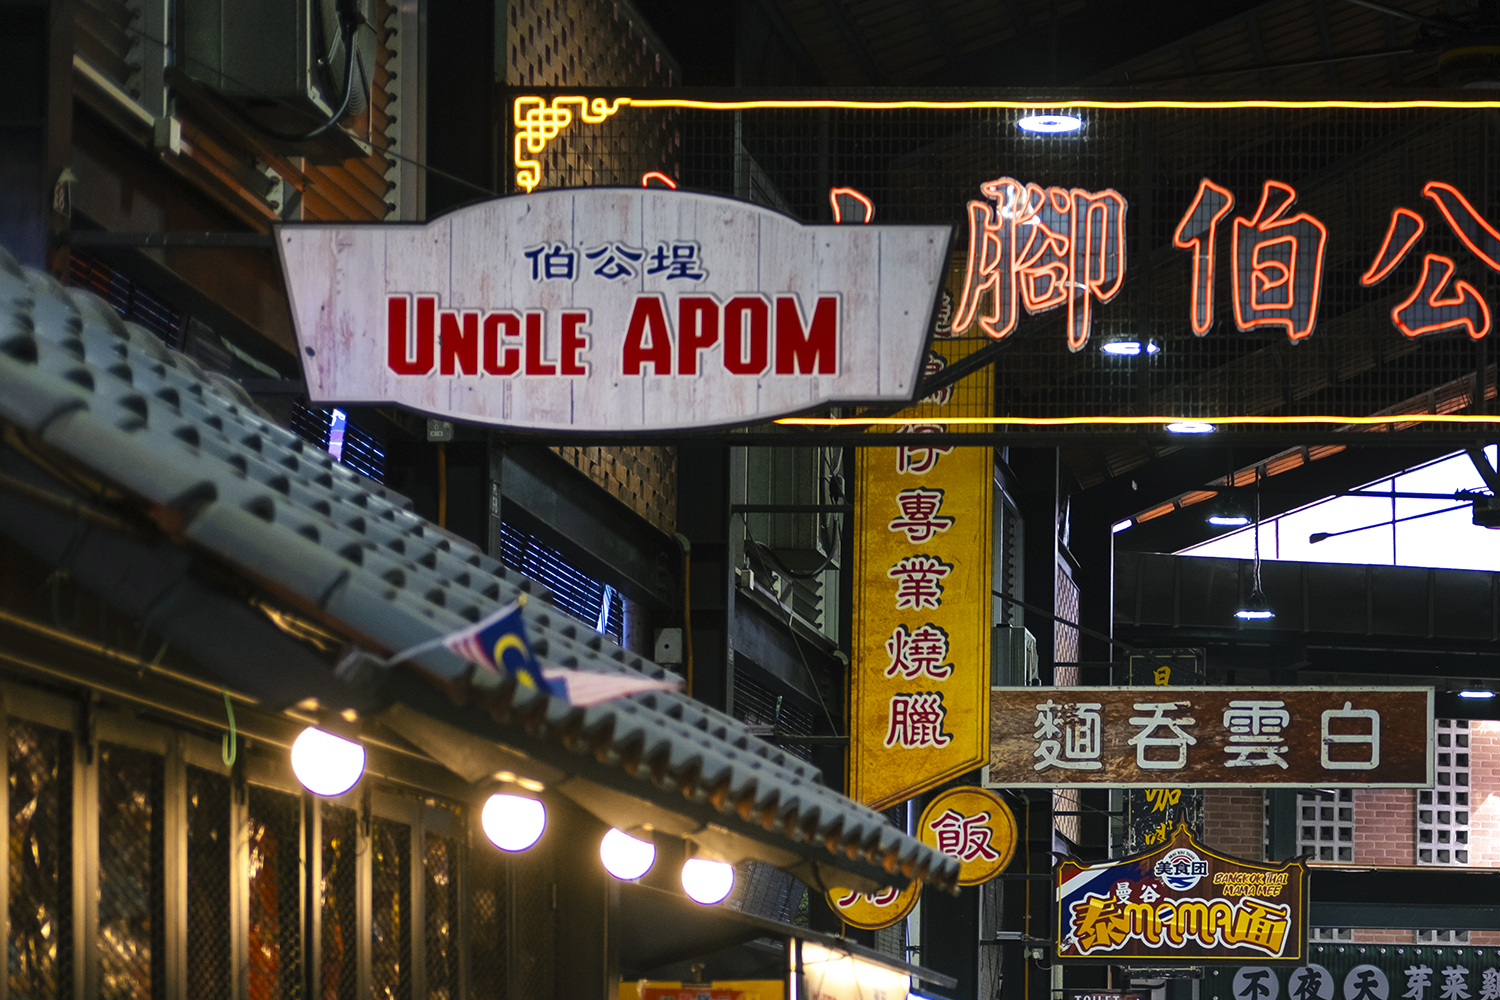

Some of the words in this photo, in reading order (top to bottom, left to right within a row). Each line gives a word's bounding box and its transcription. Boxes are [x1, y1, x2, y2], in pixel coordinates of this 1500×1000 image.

[524, 241, 711, 282] 伯公埕
[386, 293, 592, 378] UNCLE
[621, 292, 839, 377] APOM
[1155, 860, 1209, 876] 美食团
[1213, 872, 1265, 885] BANGKOK
[1265, 872, 1289, 885] THAI
[1116, 881, 1161, 905] 曼谷
[1223, 884, 1256, 896] MAMA
[1257, 884, 1283, 896] MEE
